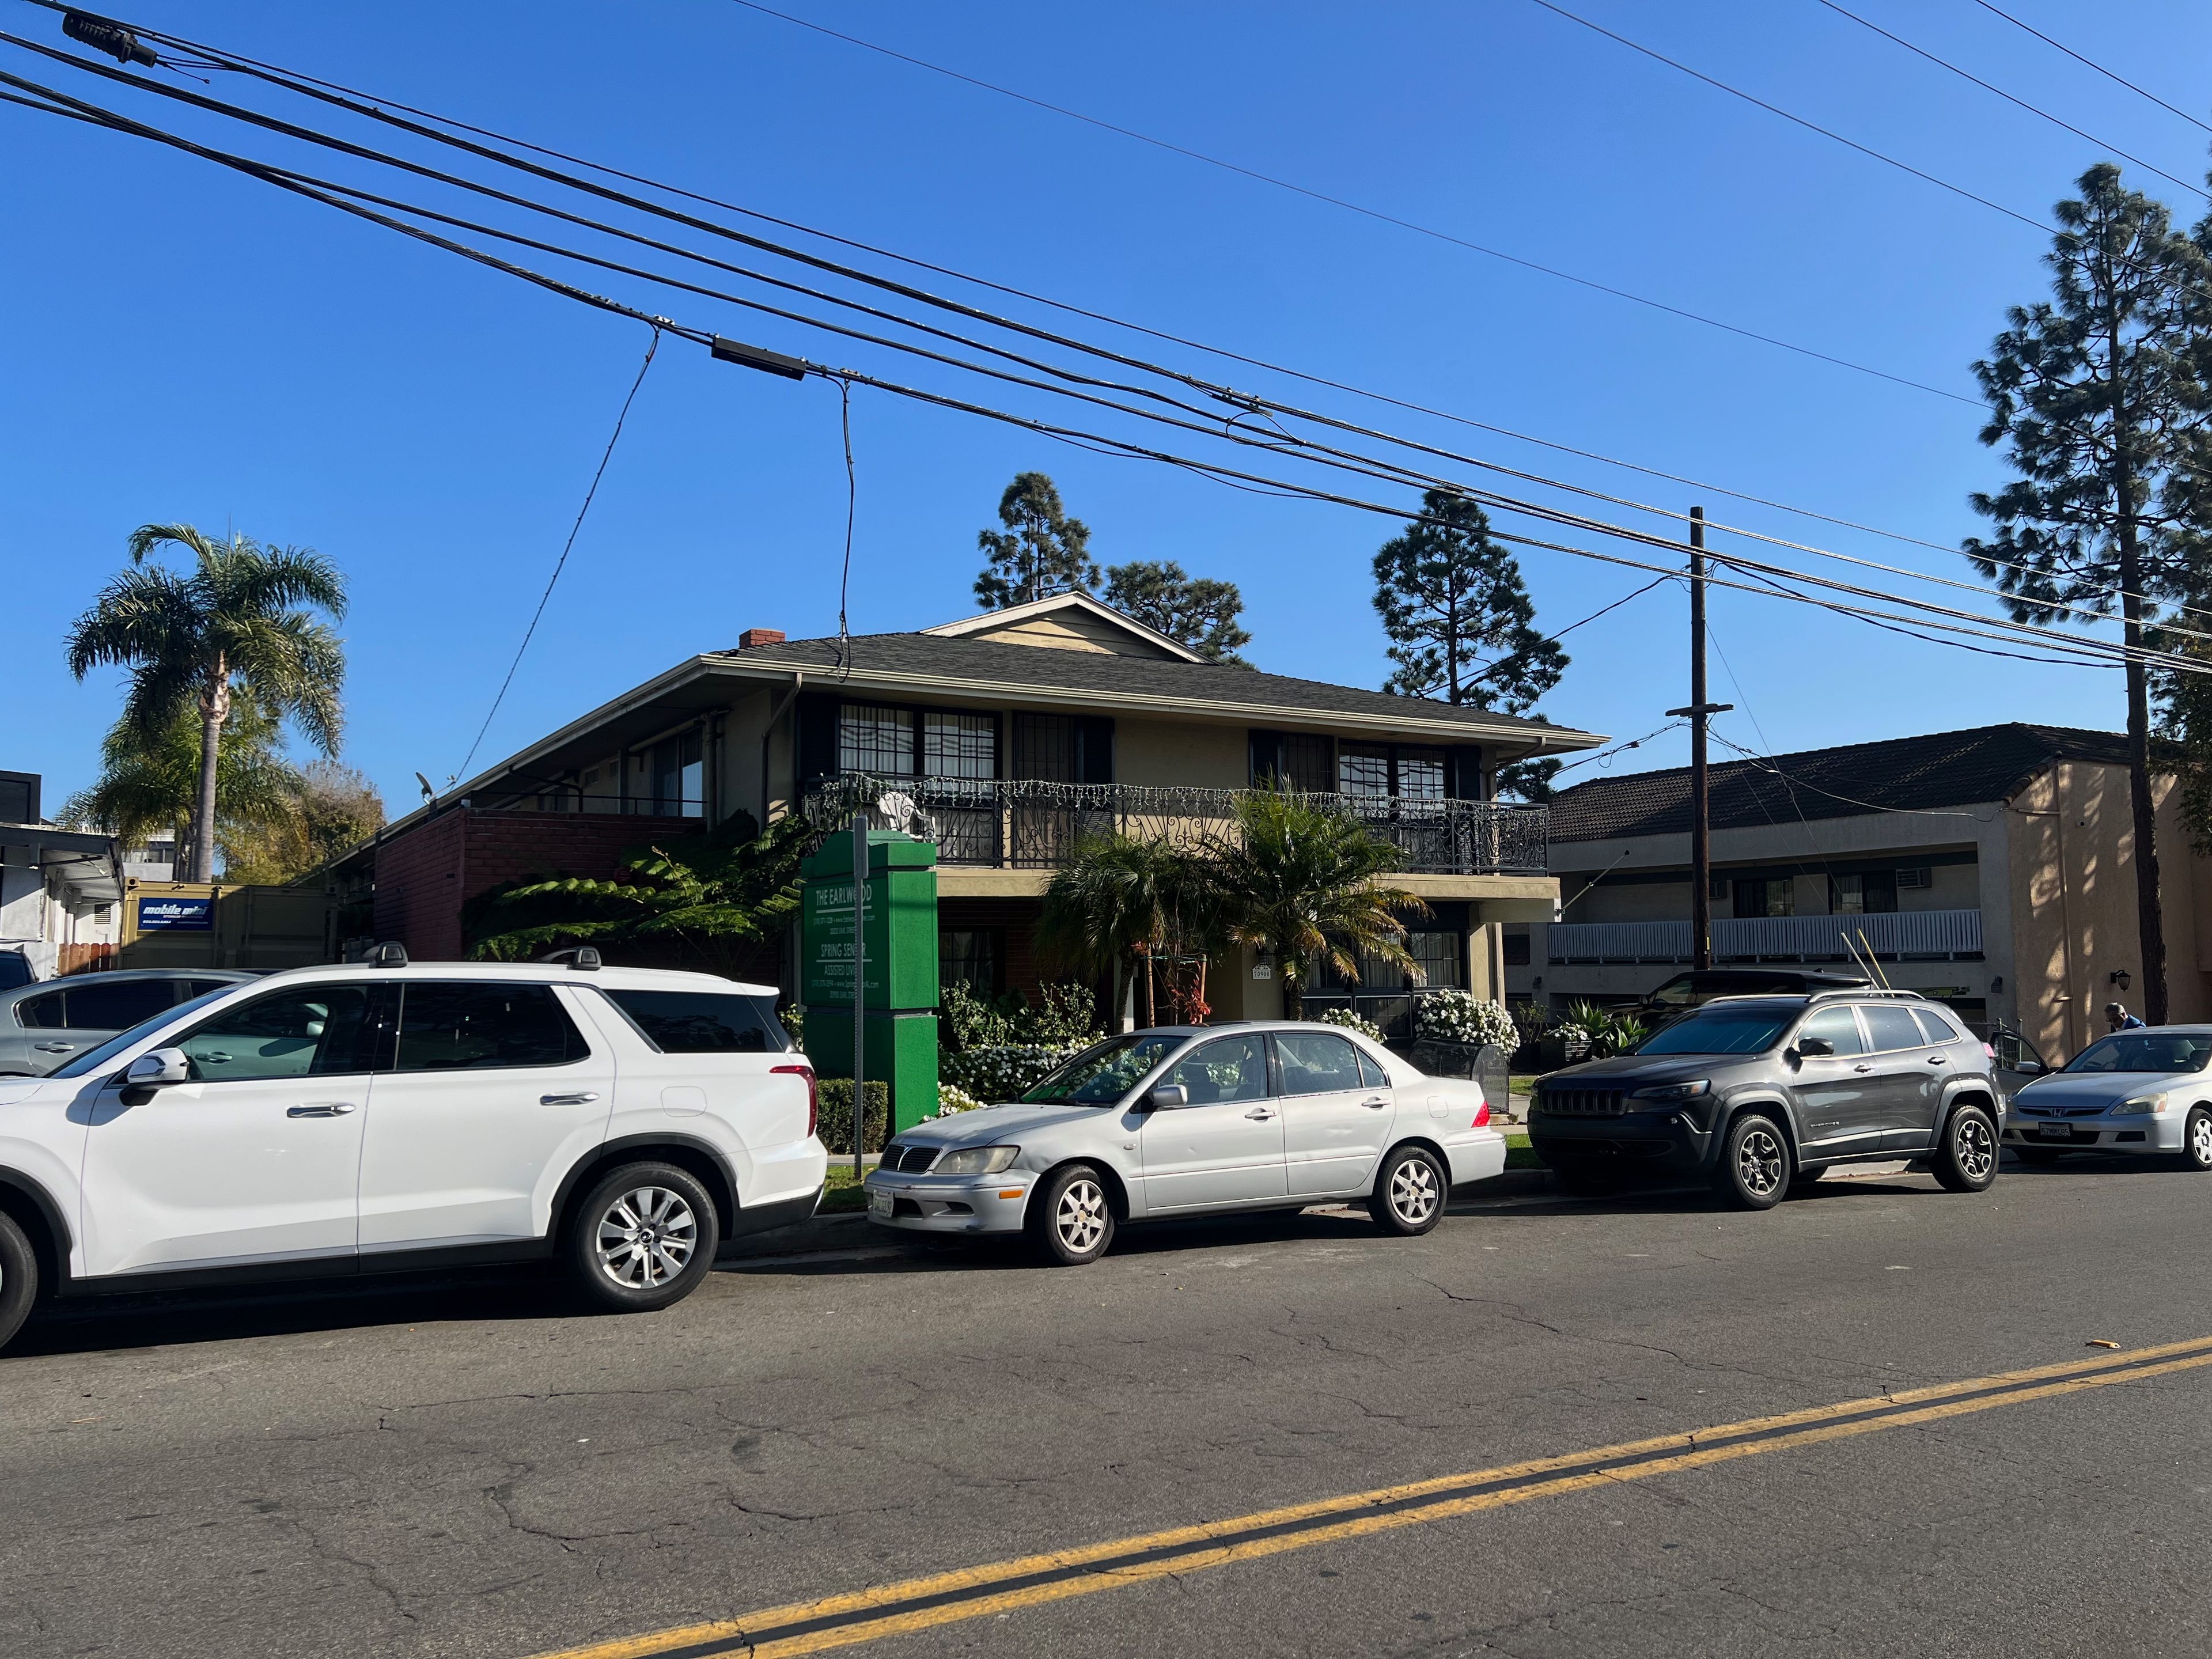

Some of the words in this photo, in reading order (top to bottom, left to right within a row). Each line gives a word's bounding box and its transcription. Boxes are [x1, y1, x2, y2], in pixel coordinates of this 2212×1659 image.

[816, 889, 828, 906] THE
[143, 904, 182, 914] mobile
[181, 906, 209, 915] mini
[821, 942, 842, 957] SPRING
[843, 942, 866, 957] SENR
[824, 965, 844, 975] ASSISTED
[846, 965, 856, 975] LIVI
